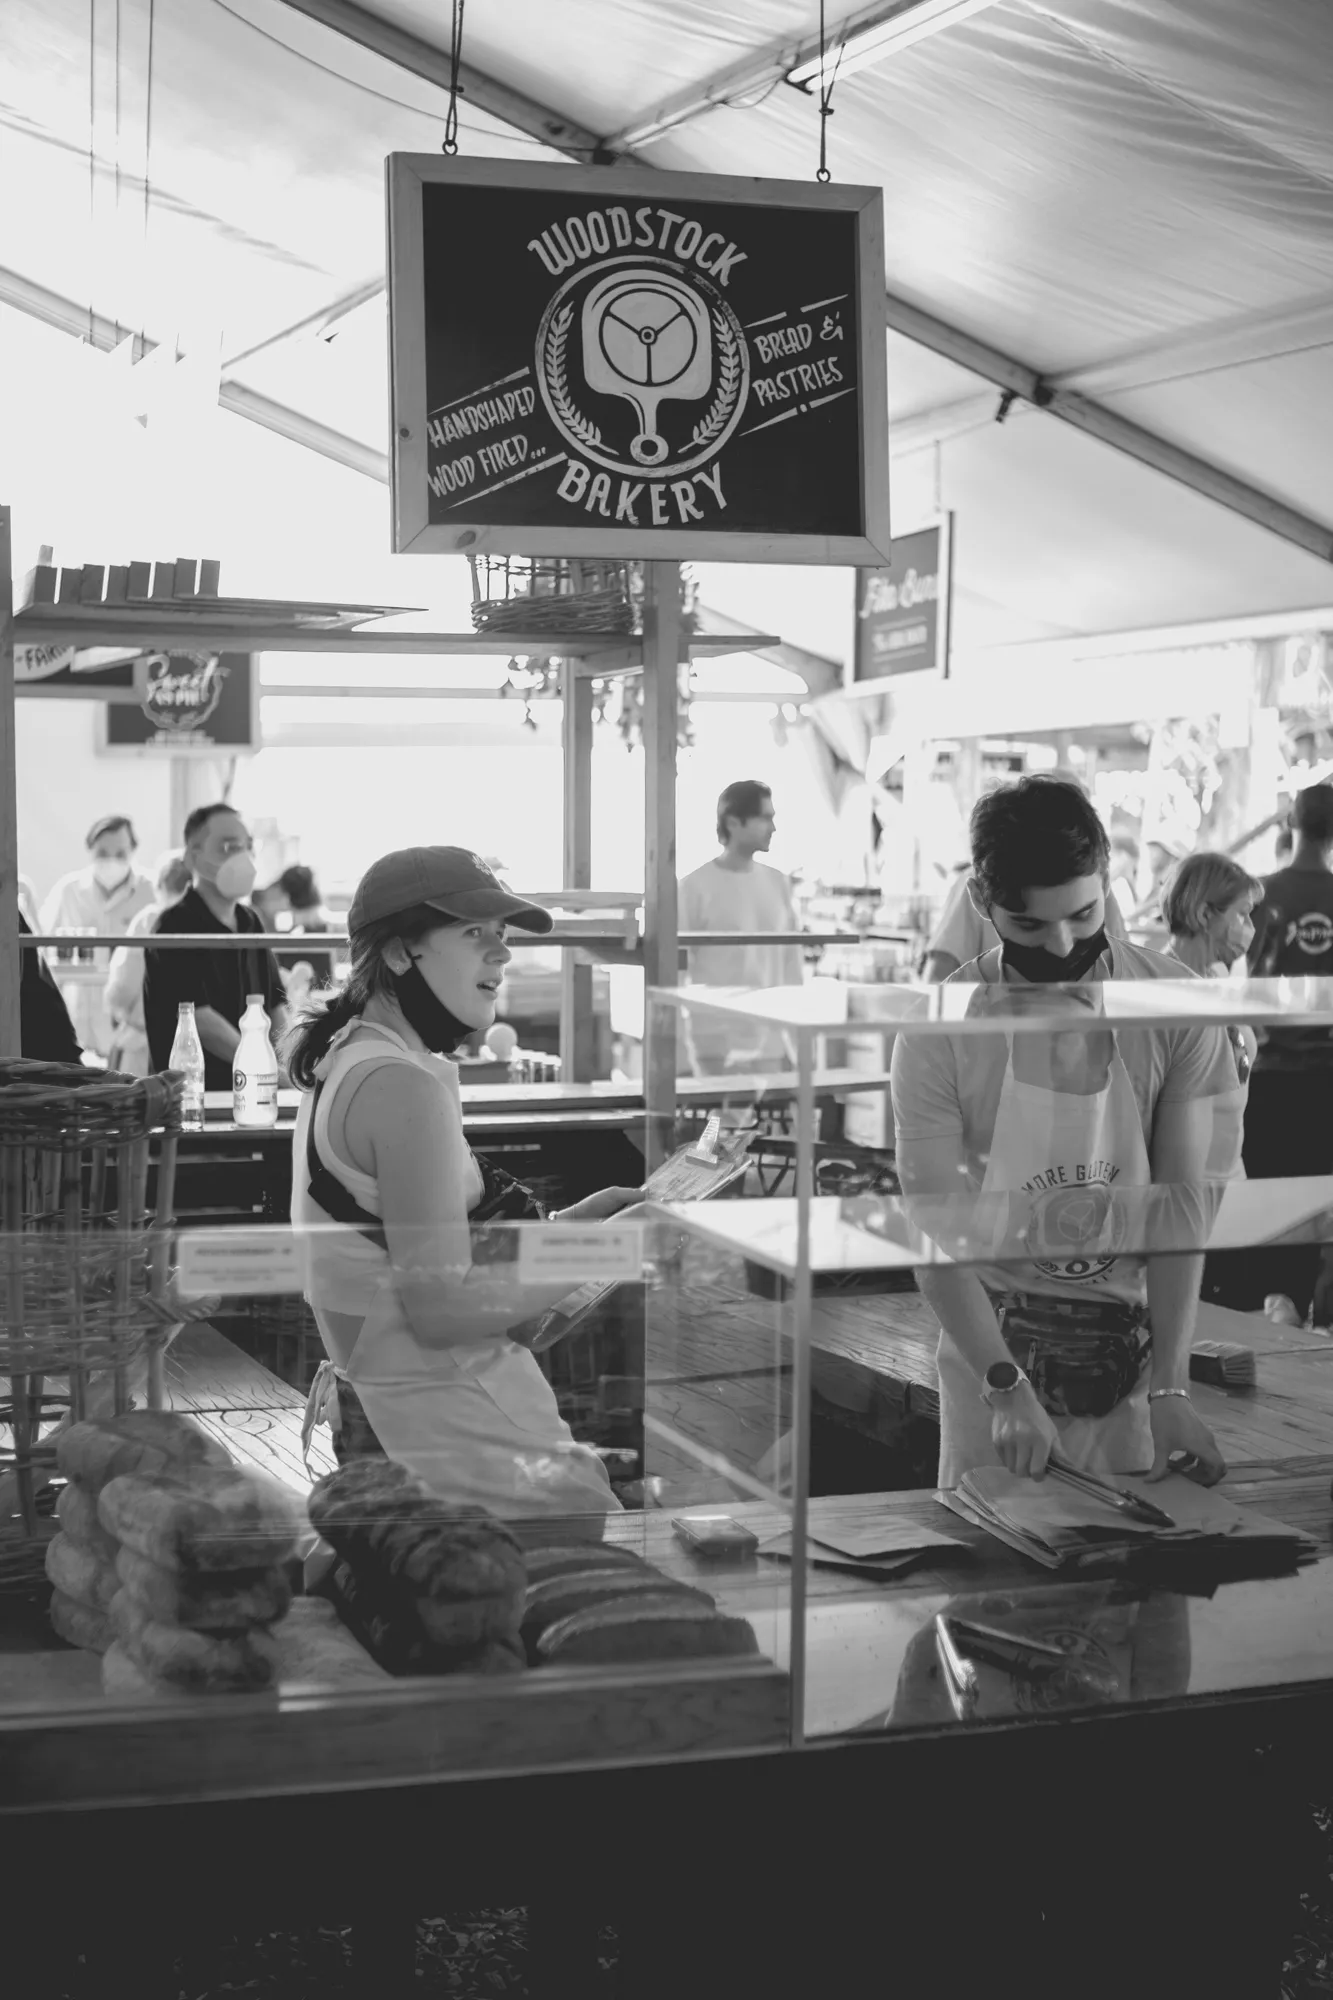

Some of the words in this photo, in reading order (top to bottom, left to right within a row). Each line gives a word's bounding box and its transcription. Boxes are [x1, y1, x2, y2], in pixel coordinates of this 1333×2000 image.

[527, 205, 748, 287] WOODSTOCK
[753, 323, 813, 364] BREAD
[819, 311, 844, 341] &
[751, 356, 844, 407] PASTRIES
[426, 386, 535, 449] HANDSHAPED
[427, 455, 475, 498] WOOD
[556, 461, 729, 526] BAKERY
[1020, 1165, 1069, 1197] MORE
[1076, 1160, 1121, 1184] GLUTEN
